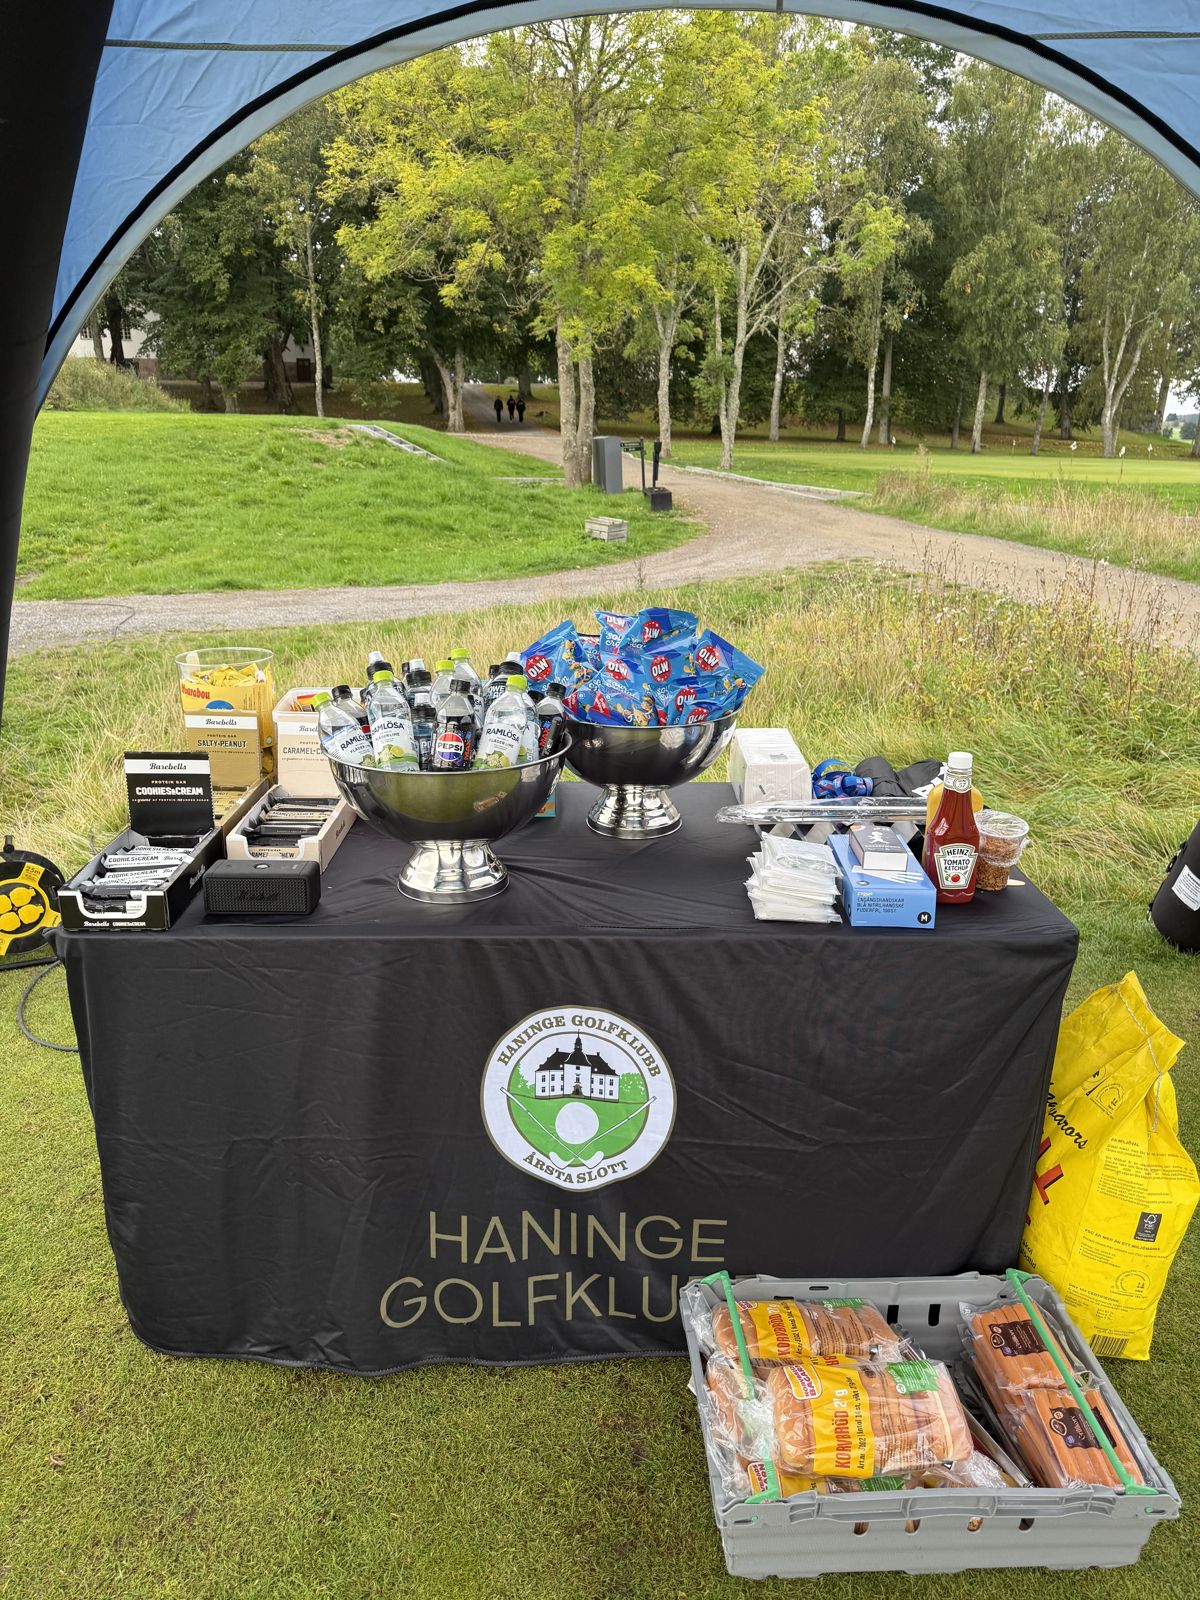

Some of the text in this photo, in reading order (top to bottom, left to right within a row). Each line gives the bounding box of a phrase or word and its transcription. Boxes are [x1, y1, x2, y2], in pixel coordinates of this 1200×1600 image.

[699, 648, 718, 667] OLW
[528, 658, 549, 678] OLW
[608, 662, 628, 676] OLW
[652, 662, 668, 676] OLW
[486, 728, 520, 742] RAMLÖSA
[438, 742, 462, 752] PEPSI
[946, 848, 969, 856] HEINZ
[496, 1014, 661, 1078] HANINGE GOLFKLUBB
[524, 1151, 628, 1184] ÅRSTA SLOTT
[430, 1208, 728, 1264] HANINGE
[768, 1313, 791, 1356] KORVBRÖD
[832, 1410, 852, 1469] KORVBRÖD
